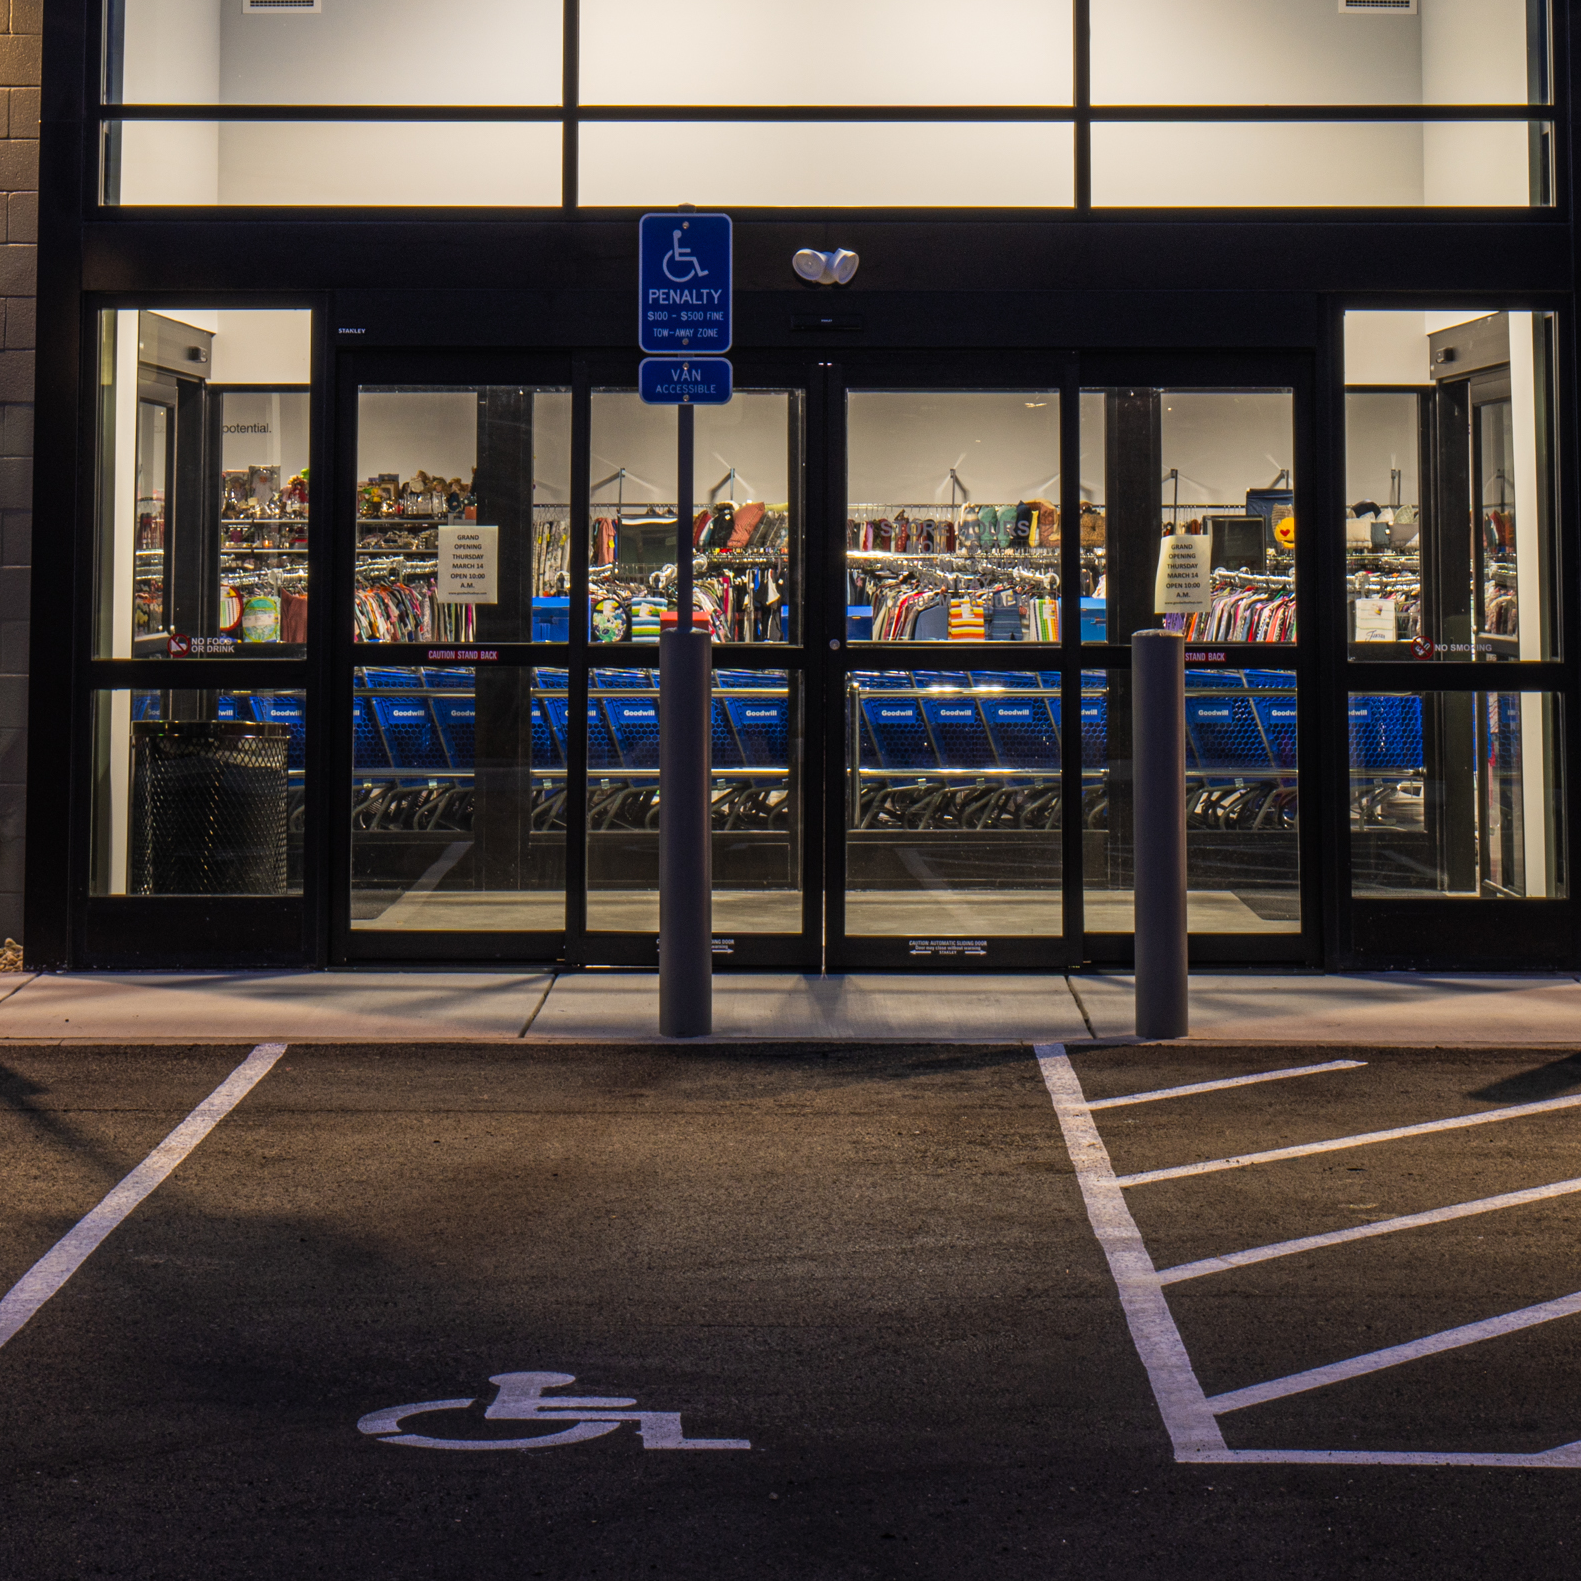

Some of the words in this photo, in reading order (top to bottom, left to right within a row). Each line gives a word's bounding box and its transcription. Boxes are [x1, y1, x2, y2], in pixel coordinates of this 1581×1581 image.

[648, 289, 722, 304] PENALTY
[647, 311, 668, 320] $100
[681, 311, 703, 320] $500
[707, 311, 724, 320] FINE
[653, 328, 694, 337] TOW-AWAY
[697, 328, 718, 337] ZONE
[671, 369, 701, 381] VAN
[656, 384, 716, 394] ACCESSIBLE
[222, 423, 272, 435] potential.
[880, 520, 950, 537] STORE
[958, 520, 1030, 537] HOURS
[191, 637, 205, 645] NO
[191, 645, 205, 653] OR
[206, 645, 235, 653] DRINK
[1434, 644, 1448, 652] NO
[428, 650, 455, 659] CAUTION
[457, 650, 478, 659] STAND
[480, 650, 498, 659] BACK
[1185, 652, 1206, 661] STAND
[1208, 652, 1225, 661] BACK
[270, 709, 302, 717] Goodwill
[393, 709, 425, 717] Goodwill
[623, 709, 655, 717] Goodwill
[746, 709, 777, 717] Goodwill
[881, 709, 913, 717] Goodwill
[940, 709, 972, 717] Goodwill
[998, 708, 1030, 716] Goodwill
